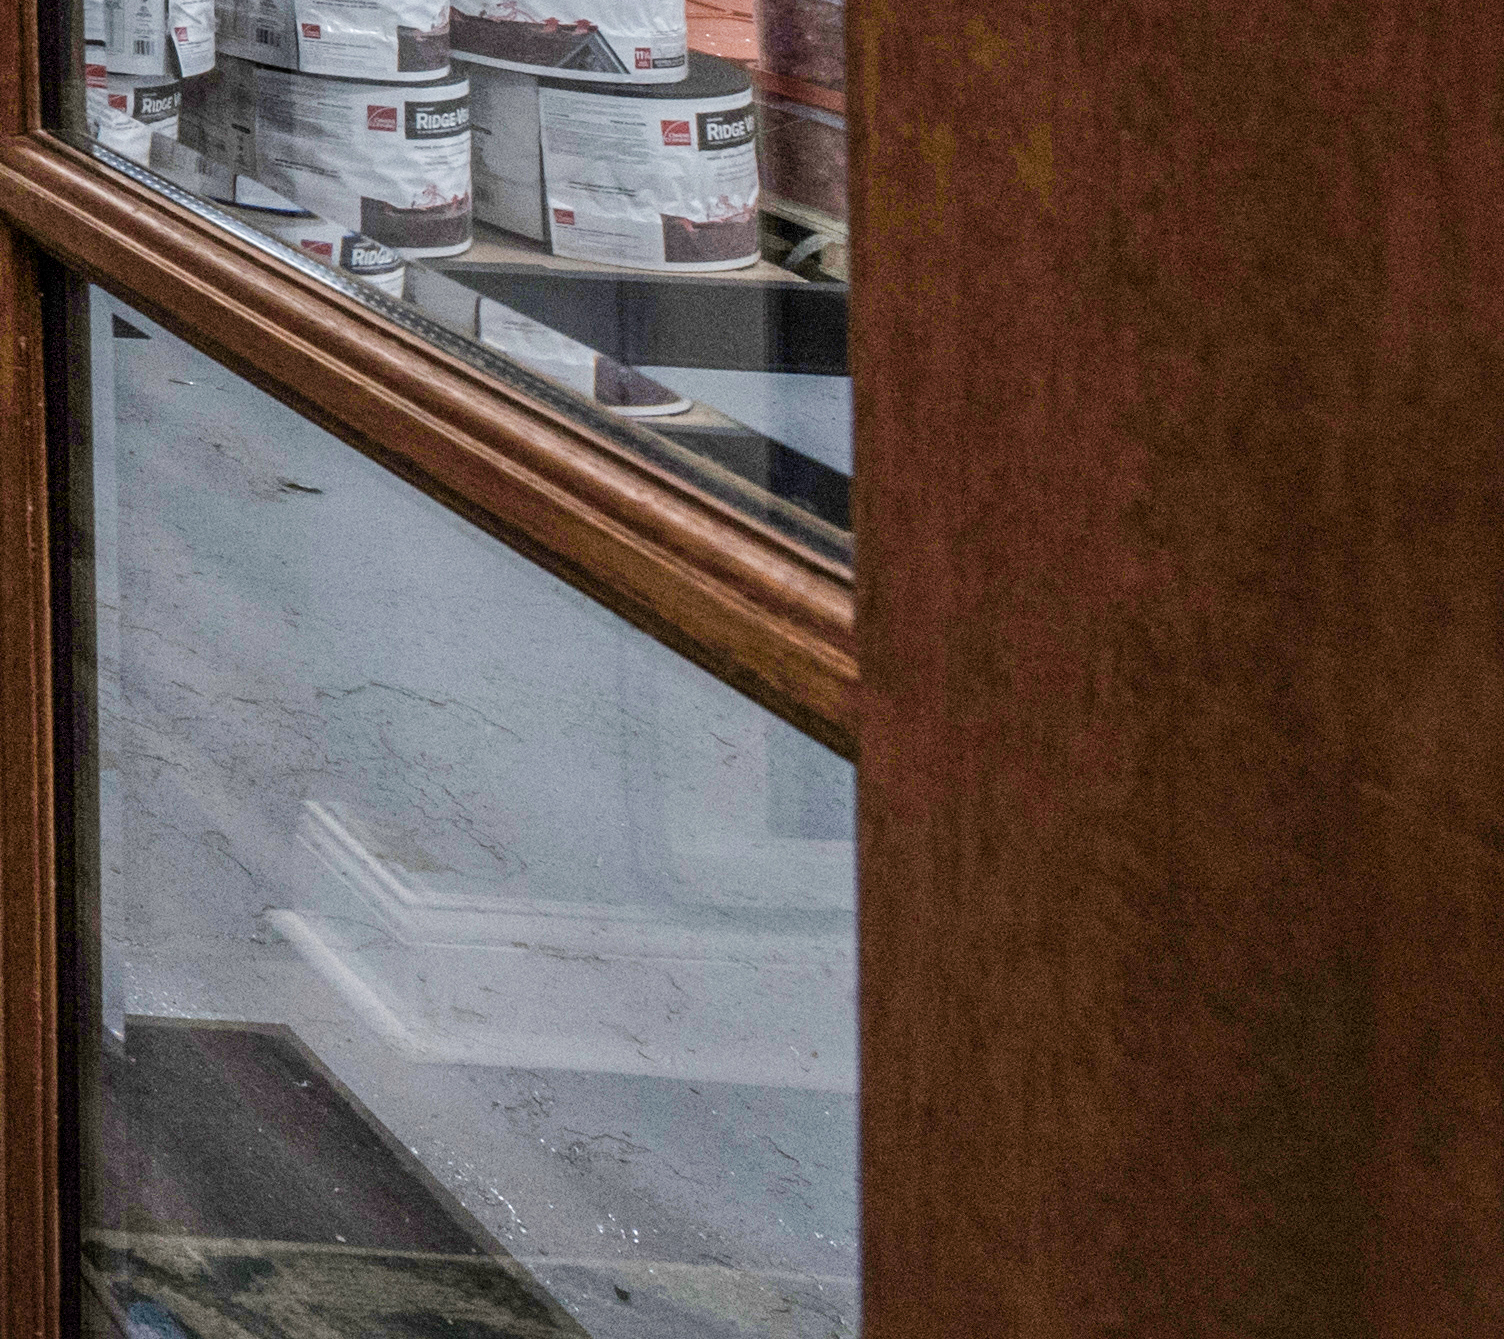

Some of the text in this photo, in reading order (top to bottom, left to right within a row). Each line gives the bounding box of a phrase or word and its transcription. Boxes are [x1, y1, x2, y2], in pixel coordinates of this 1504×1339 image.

[142, 94, 172, 114] RIDGE
[415, 109, 457, 131] RIDGE
[706, 120, 745, 141] RIDGE
